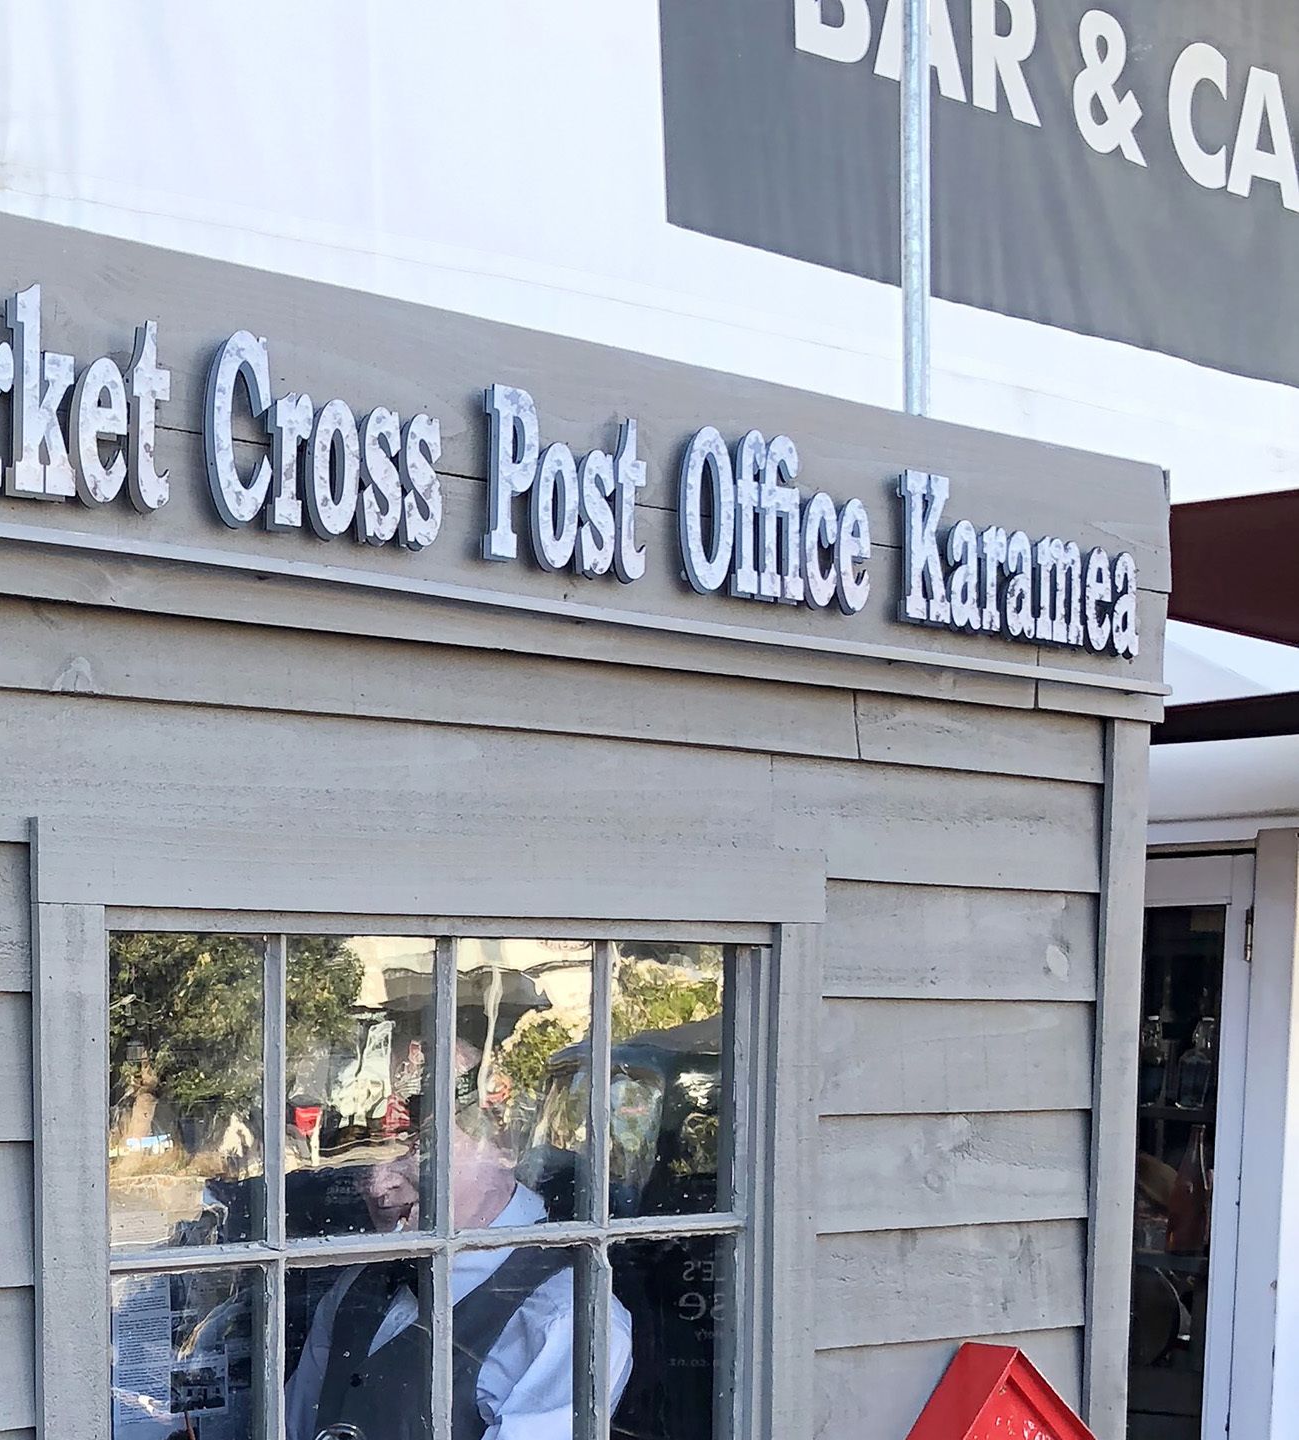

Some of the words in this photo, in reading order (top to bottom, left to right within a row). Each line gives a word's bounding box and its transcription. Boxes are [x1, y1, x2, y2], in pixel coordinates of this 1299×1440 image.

[1072, 9, 1148, 168] &
[204, 329, 442, 550] Cross
[482, 383, 647, 582] Post
[679, 425, 872, 614] Office
[898, 469, 1140, 659] Karamea
